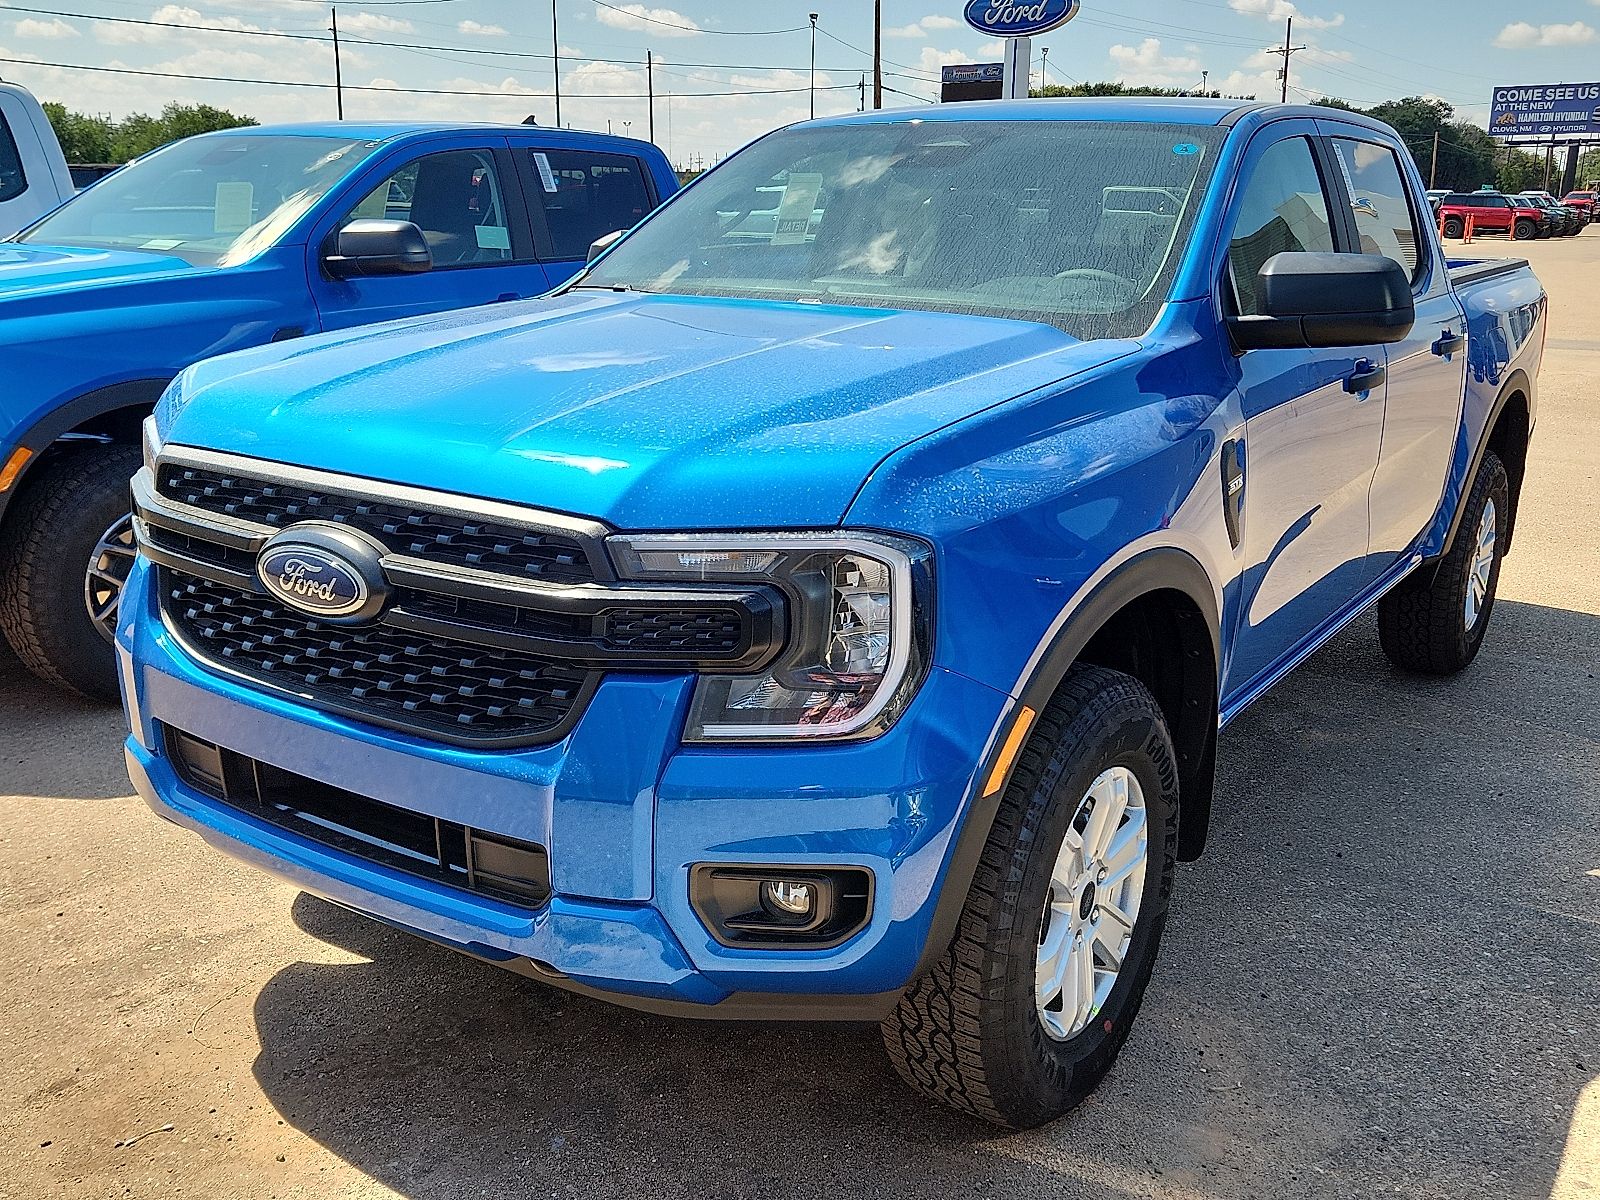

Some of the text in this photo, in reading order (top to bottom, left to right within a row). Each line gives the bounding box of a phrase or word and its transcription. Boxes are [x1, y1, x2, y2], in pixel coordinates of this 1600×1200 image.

[984, 0, 1047, 25] Ford
[986, 67, 1000, 76] Ford
[1496, 86, 1599, 102] COME SEE US
[1494, 102, 1554, 111] AT THE NEW
[1518, 111, 1588, 122] HAMILTON HYUNDAI
[1491, 125, 1519, 133] CLOVIS,
[279, 558, 337, 601] Ford
[1147, 733, 1178, 899] GOODYEAR
